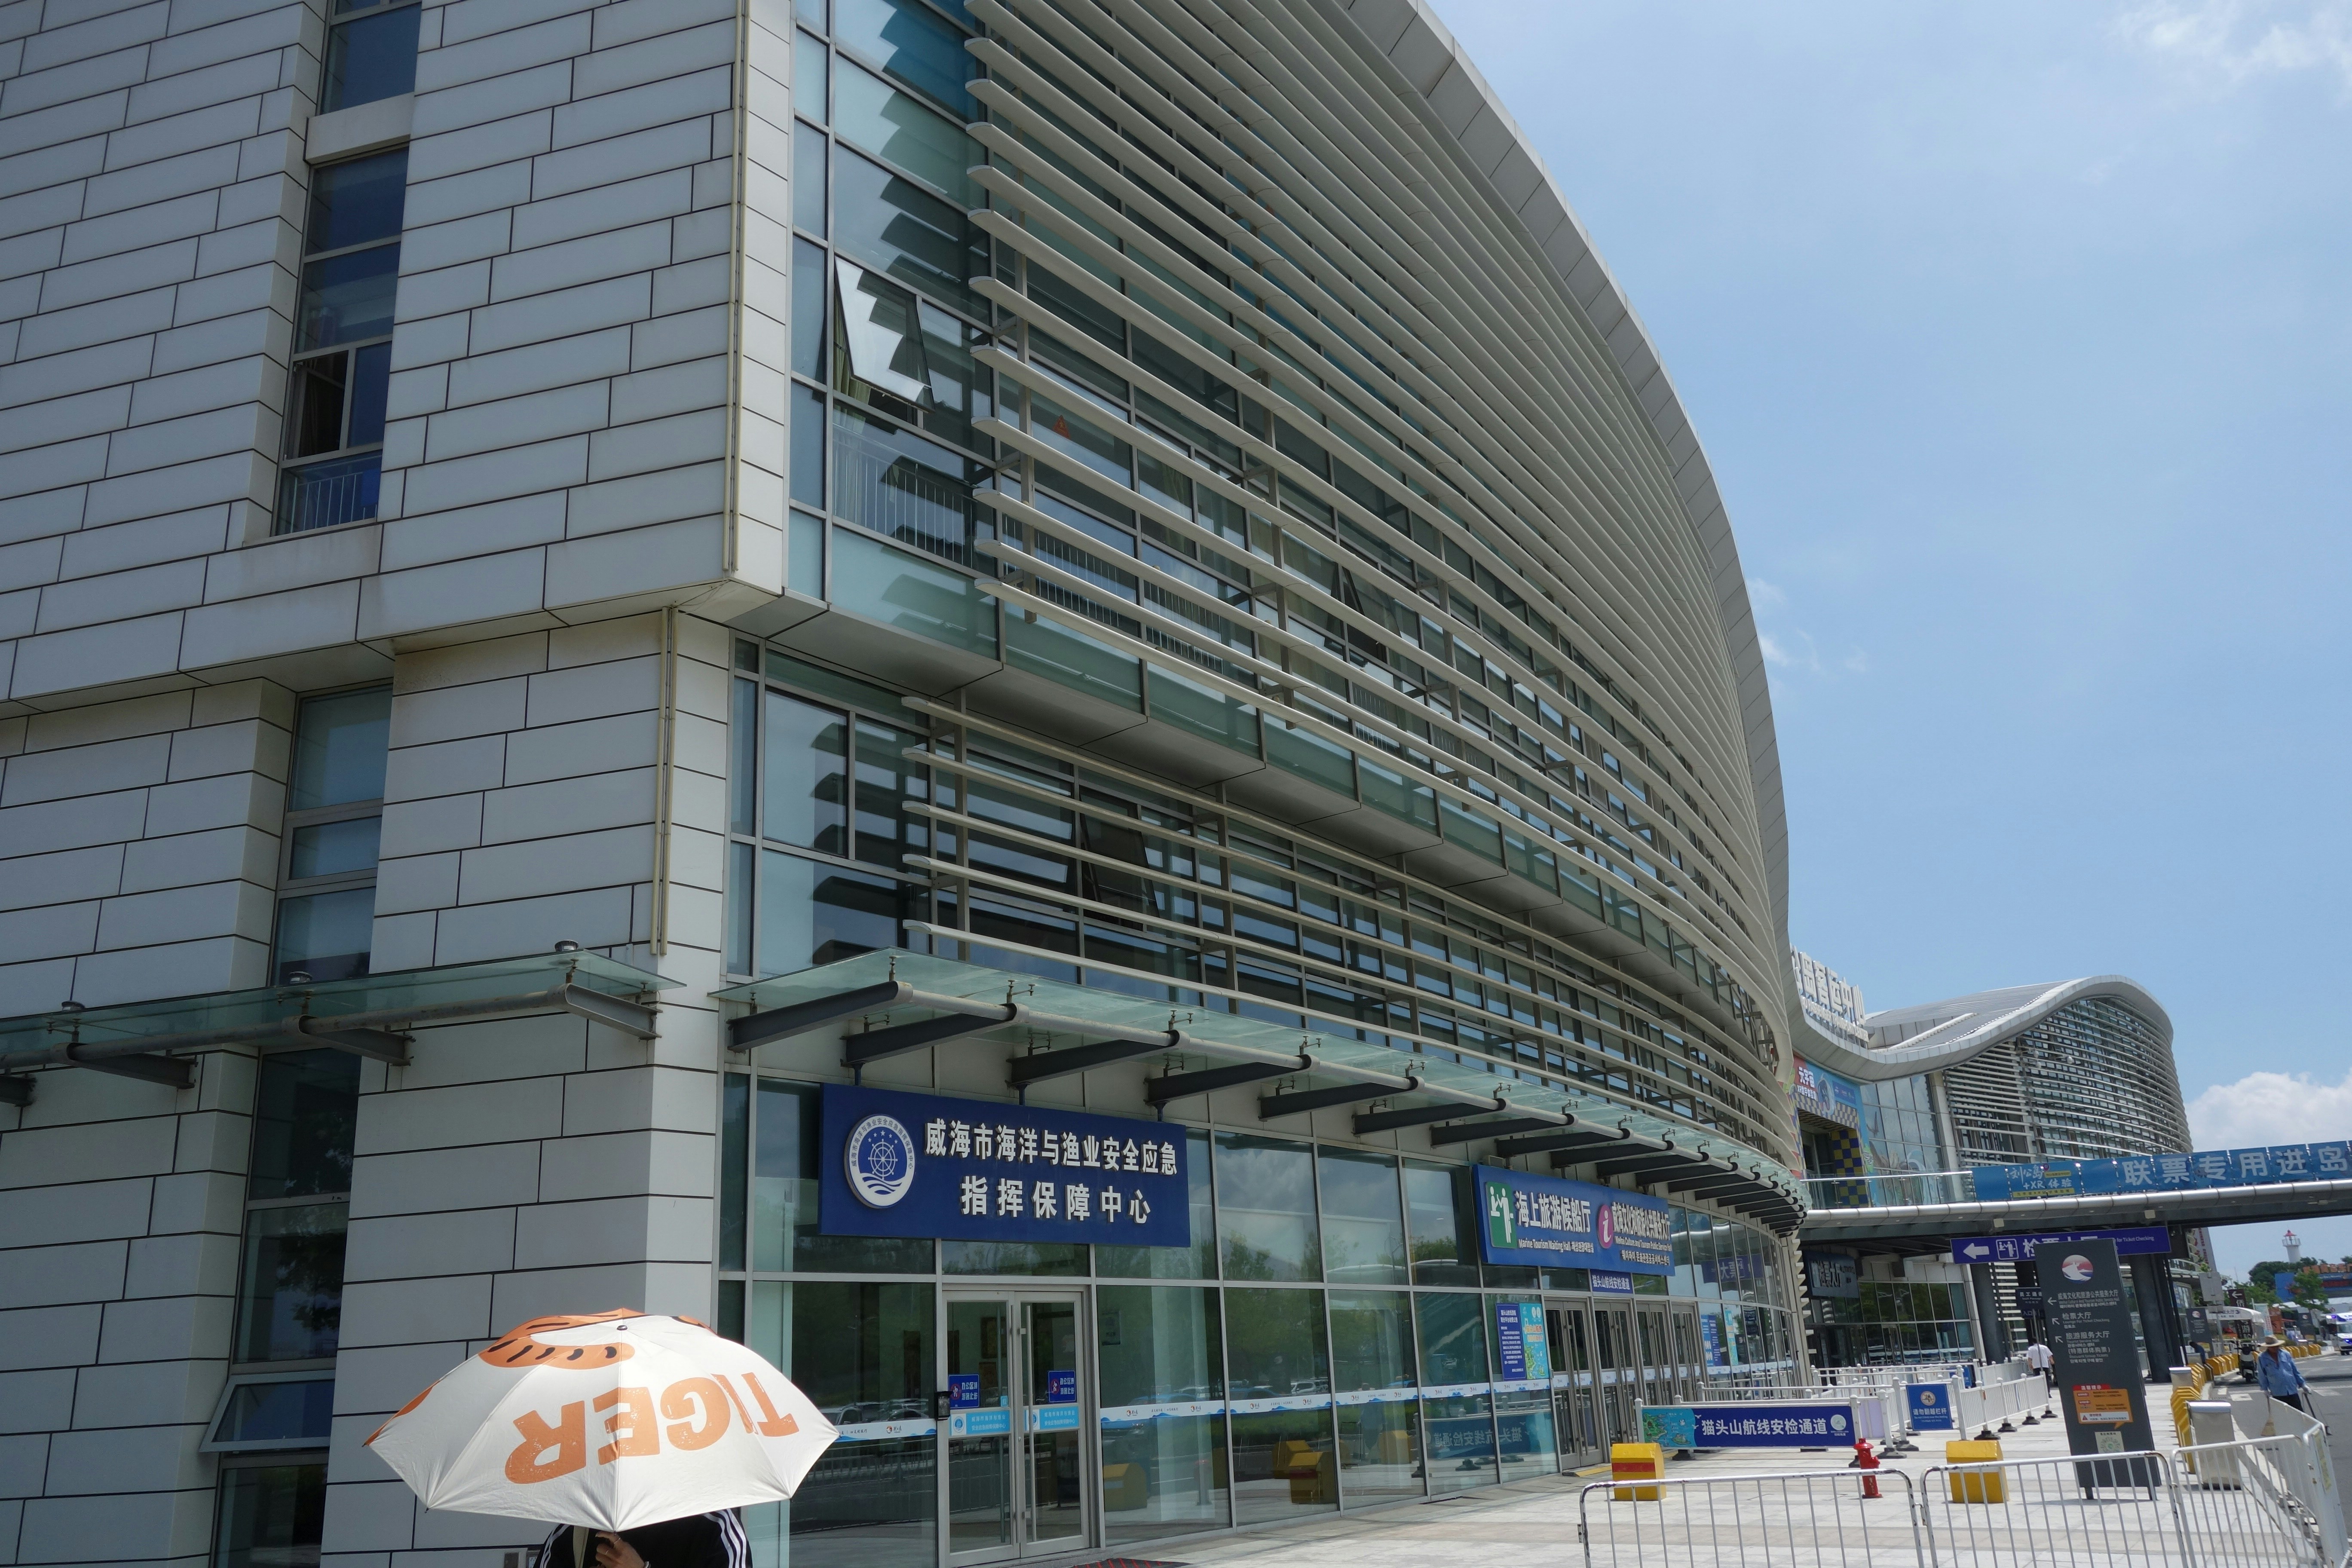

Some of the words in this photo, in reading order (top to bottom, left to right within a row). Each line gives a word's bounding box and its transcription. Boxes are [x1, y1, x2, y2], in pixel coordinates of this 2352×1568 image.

[1798, 1066, 1815, 1088] 元宇宙
[924, 1118, 1177, 1175] 威海市海洋与渔业安全应急
[2009, 1164, 2043, 1185] 刘公岛
[2122, 1145, 2348, 1186] 联票专用进岛
[2048, 1178, 2072, 1188] 体验
[960, 1176, 1151, 1224] 指挥保障中心
[1514, 1190, 1591, 1233] 海上旅游候船厅
[1518, 1237, 1533, 1248] Marine
[1533, 1239, 1548, 1249] Tourism
[1548, 1240, 1564, 1253] Waiting
[1563, 1241, 1571, 1251] Hall
[1592, 1275, 1630, 1290] 猫头山航线安检通道
[2062, 1312, 2092, 1320] 检票大厅
[2066, 1331, 2110, 1340] 旅游服务大厅
[1913, 1407, 1947, 1415] 请勿翻越栏杆
[505, 1372, 799, 1485] TIGER
[1702, 1418, 1828, 1436] 猫头山航线安检通道
